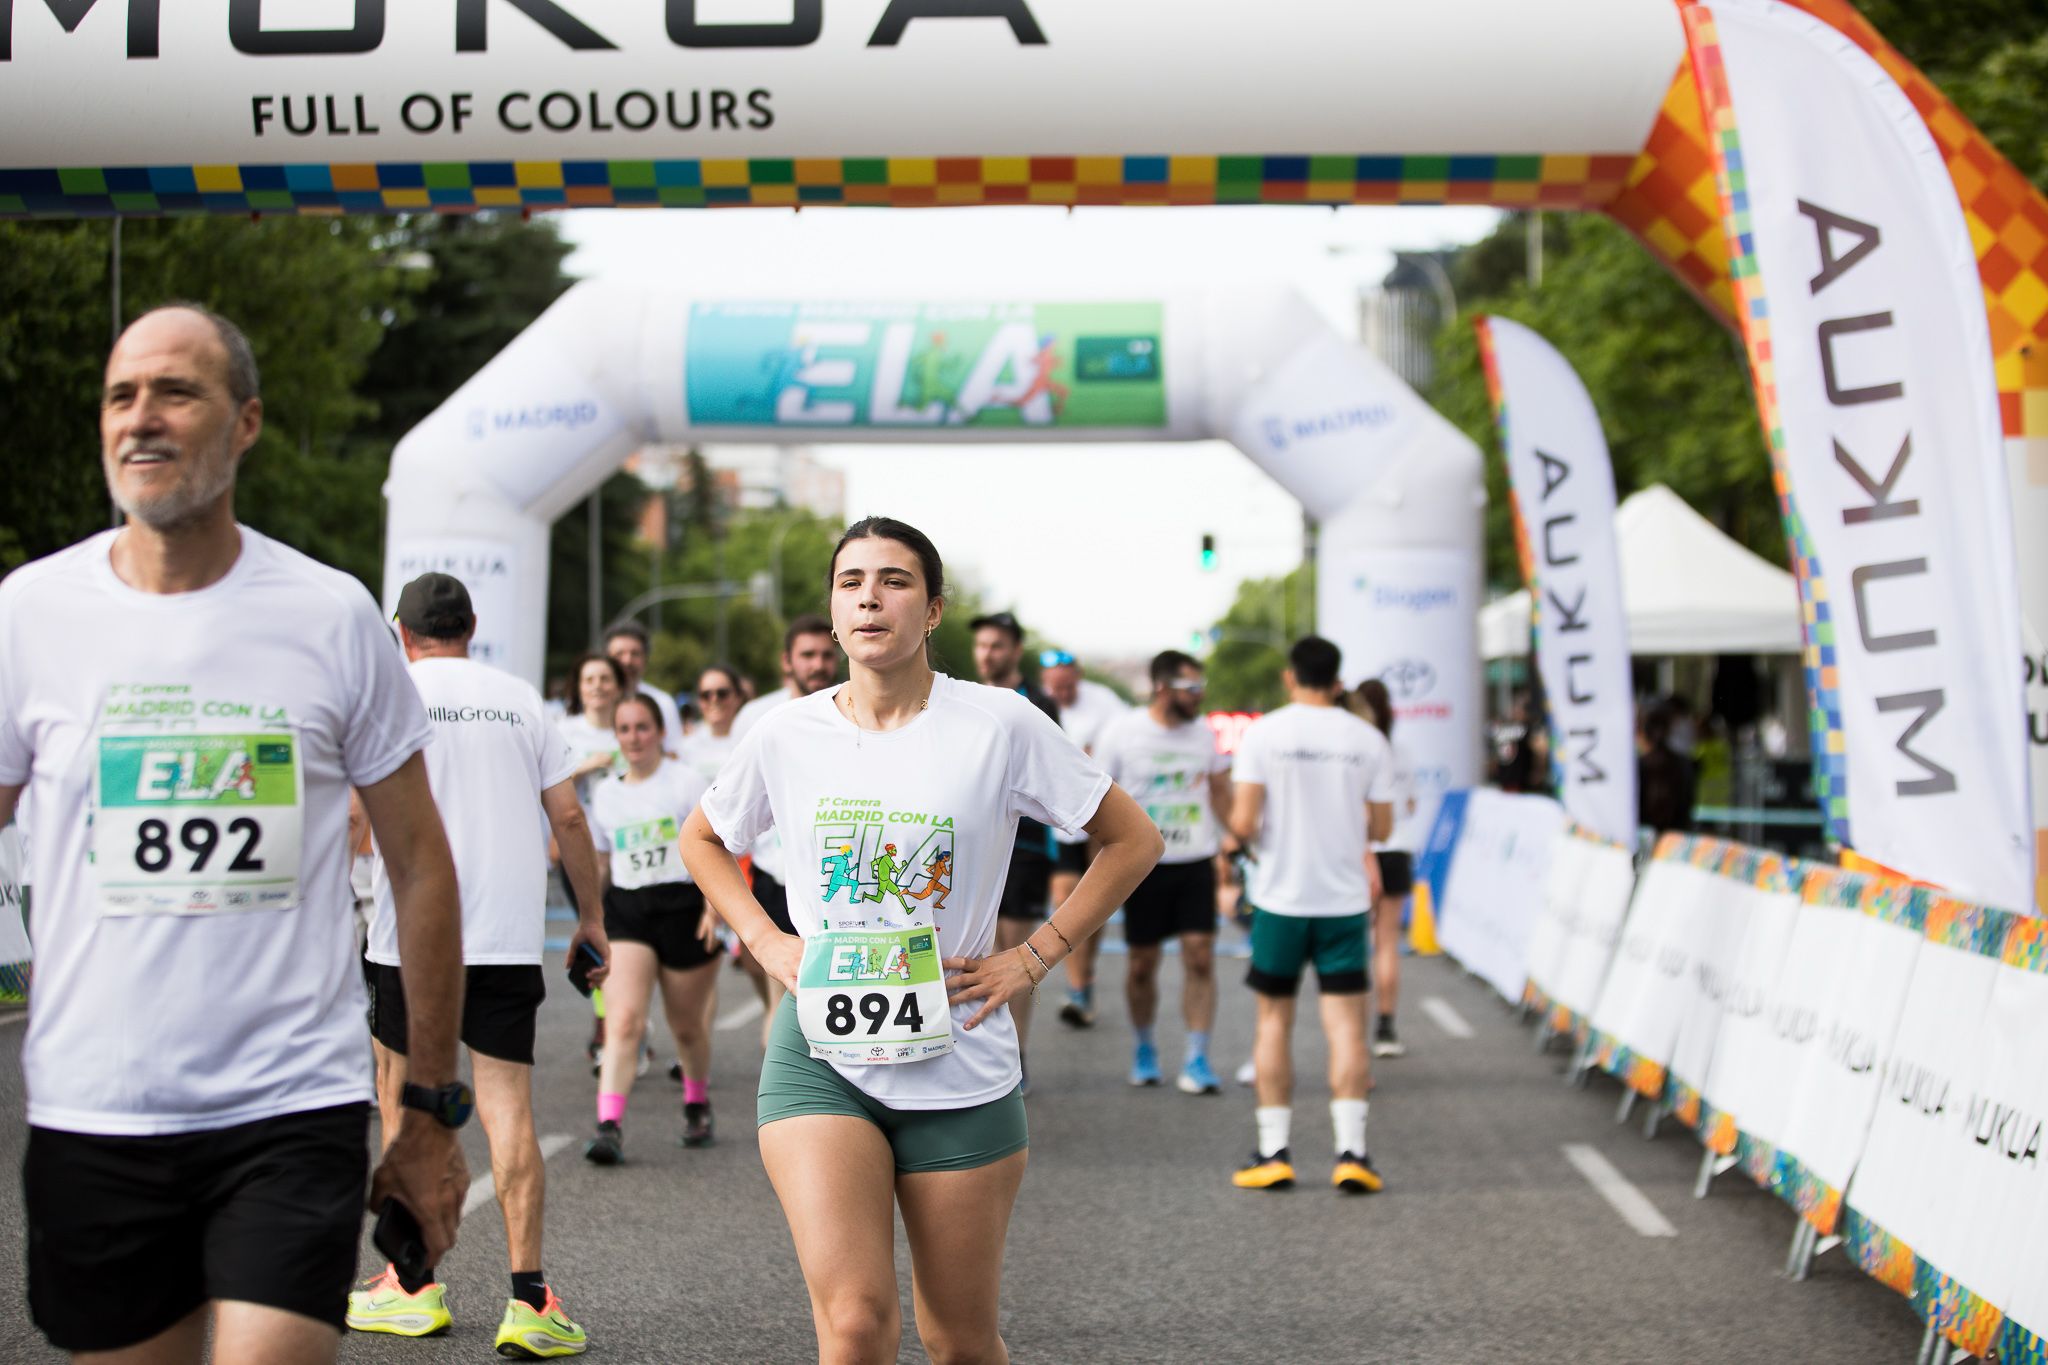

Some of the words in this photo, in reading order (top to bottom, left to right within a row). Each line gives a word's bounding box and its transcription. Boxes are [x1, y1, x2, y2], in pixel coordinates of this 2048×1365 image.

[251, 94, 380, 136] FULL
[400, 92, 472, 134] OF
[498, 89, 774, 133] COLOURS
[776, 322, 1054, 424] ELA
[106, 700, 196, 717] MADRID
[203, 701, 252, 718] CON
[260, 706, 287, 720] LA
[136, 751, 257, 801] ELA
[815, 810, 884, 823] MADRID
[888, 812, 928, 825] CON
[931, 815, 954, 828] LA
[832, 797, 881, 808] Carrera
[135, 817, 265, 873] 892
[630, 846, 668, 872] 527
[834, 936, 868, 944] MADRID
[888, 935, 901, 944] LA
[827, 944, 911, 981] ELA
[825, 991, 924, 1036] 894
